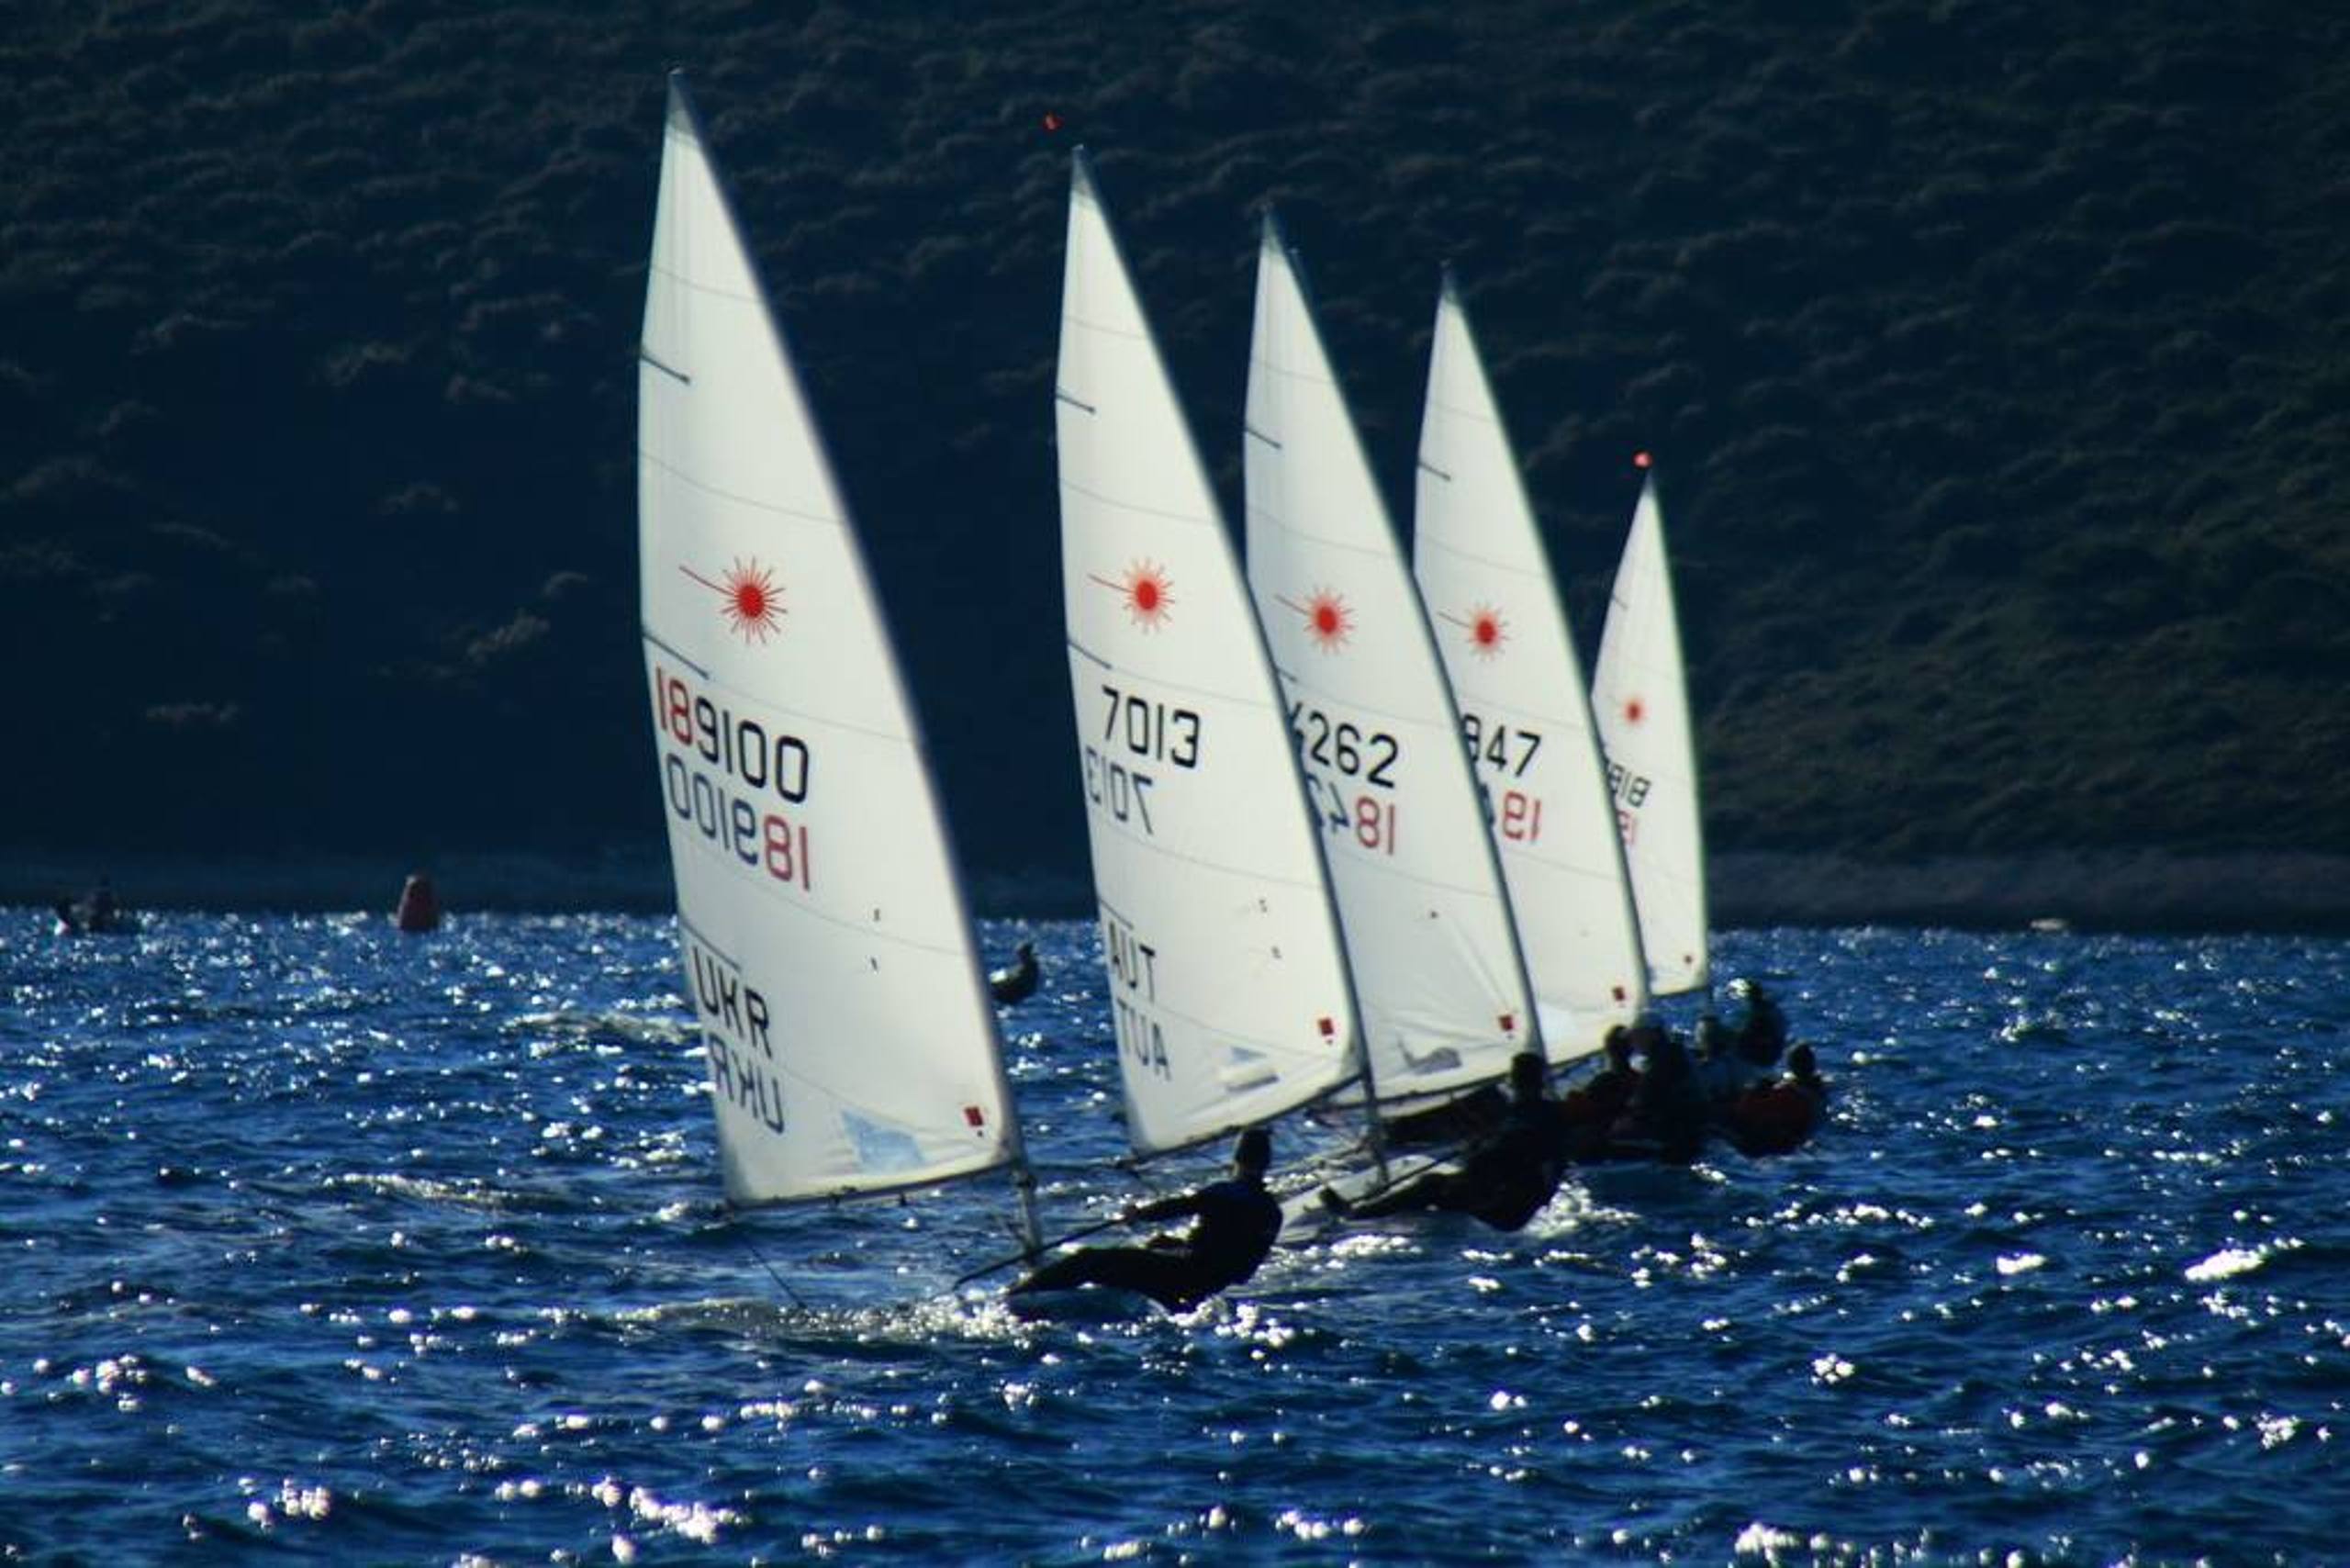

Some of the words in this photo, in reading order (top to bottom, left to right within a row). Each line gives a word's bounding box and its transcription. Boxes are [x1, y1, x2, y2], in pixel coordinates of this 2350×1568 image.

[655, 665, 809, 803] 189100
[1102, 684, 1200, 768] 7013
[692, 946, 773, 1058] UKR
[1109, 920, 1156, 1004] AUT
